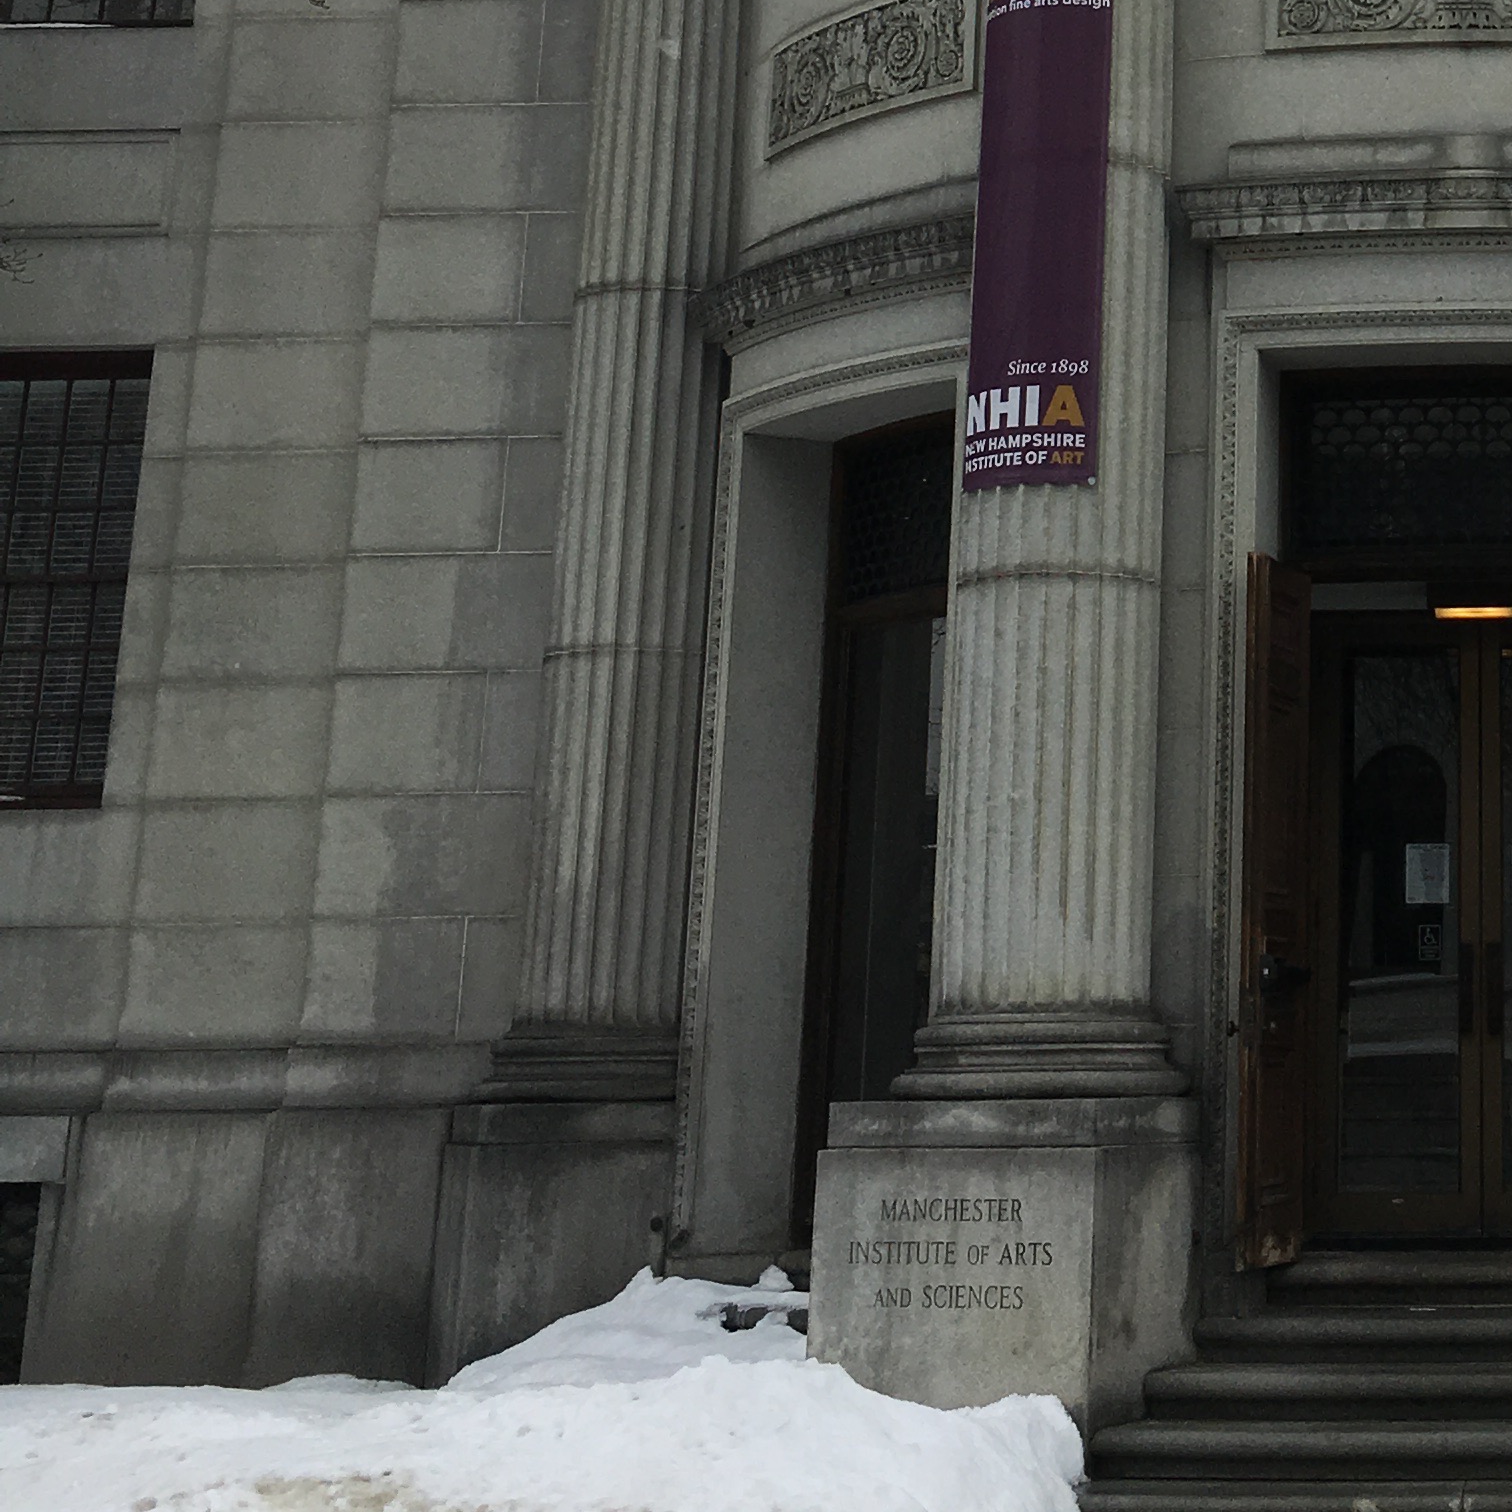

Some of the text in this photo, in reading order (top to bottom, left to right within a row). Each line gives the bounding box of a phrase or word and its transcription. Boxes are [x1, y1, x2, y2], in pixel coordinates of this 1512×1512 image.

[1009, 0, 1031, 11] fine
[1008, 359, 1088, 376] Since 1898
[967, 385, 1085, 436] NHIA
[966, 434, 1085, 457] NEW HAMPSHIRE
[1025, 451, 1047, 464] OF
[1050, 451, 1084, 464] ART
[881, 1199, 1022, 1222] MANCHESTER
[849, 1241, 1053, 1266] INSTITUTE OF ARTS
[874, 1286, 1024, 1309] AND SCIENCES
